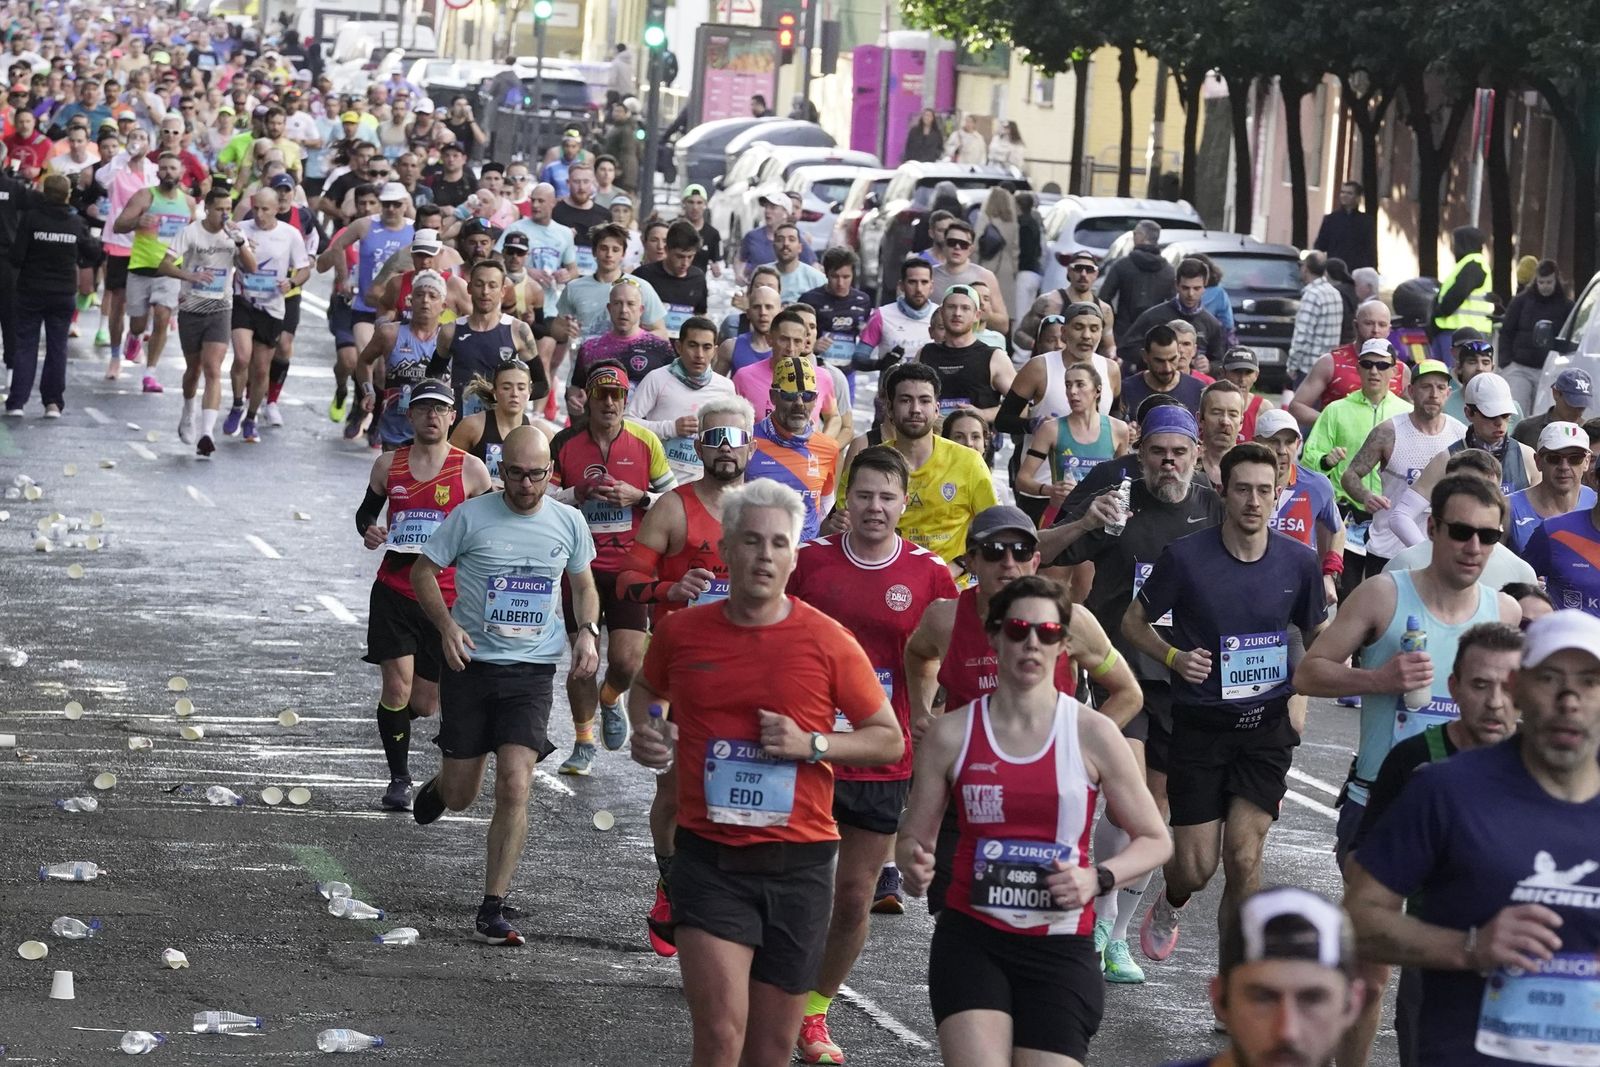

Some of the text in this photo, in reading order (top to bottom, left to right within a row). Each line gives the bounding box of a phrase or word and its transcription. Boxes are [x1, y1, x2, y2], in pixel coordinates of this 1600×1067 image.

[33, 231, 77, 243] VOLUNTEER
[1575, 379, 1590, 393] NY
[668, 448, 699, 463] EMILIO
[408, 511, 439, 519] ZURICH
[587, 510, 624, 521] KANIJO
[392, 533, 431, 544] KRISTO
[511, 581, 546, 591] ZURICH
[510, 598, 529, 608] 7079
[891, 592, 907, 602] DBU
[490, 609, 543, 624] ALBERTO
[1244, 635, 1280, 647] ZURICH
[1246, 655, 1265, 665] 8714
[1230, 666, 1280, 684] QUENTIN
[735, 771, 763, 784] 5787
[729, 787, 764, 806] EDD
[962, 784, 1004, 801] HYDE
[964, 800, 1004, 815] PARK
[1008, 845, 1062, 860] ZURICH
[1007, 870, 1037, 884] 4966
[988, 886, 1052, 908] HONOR
